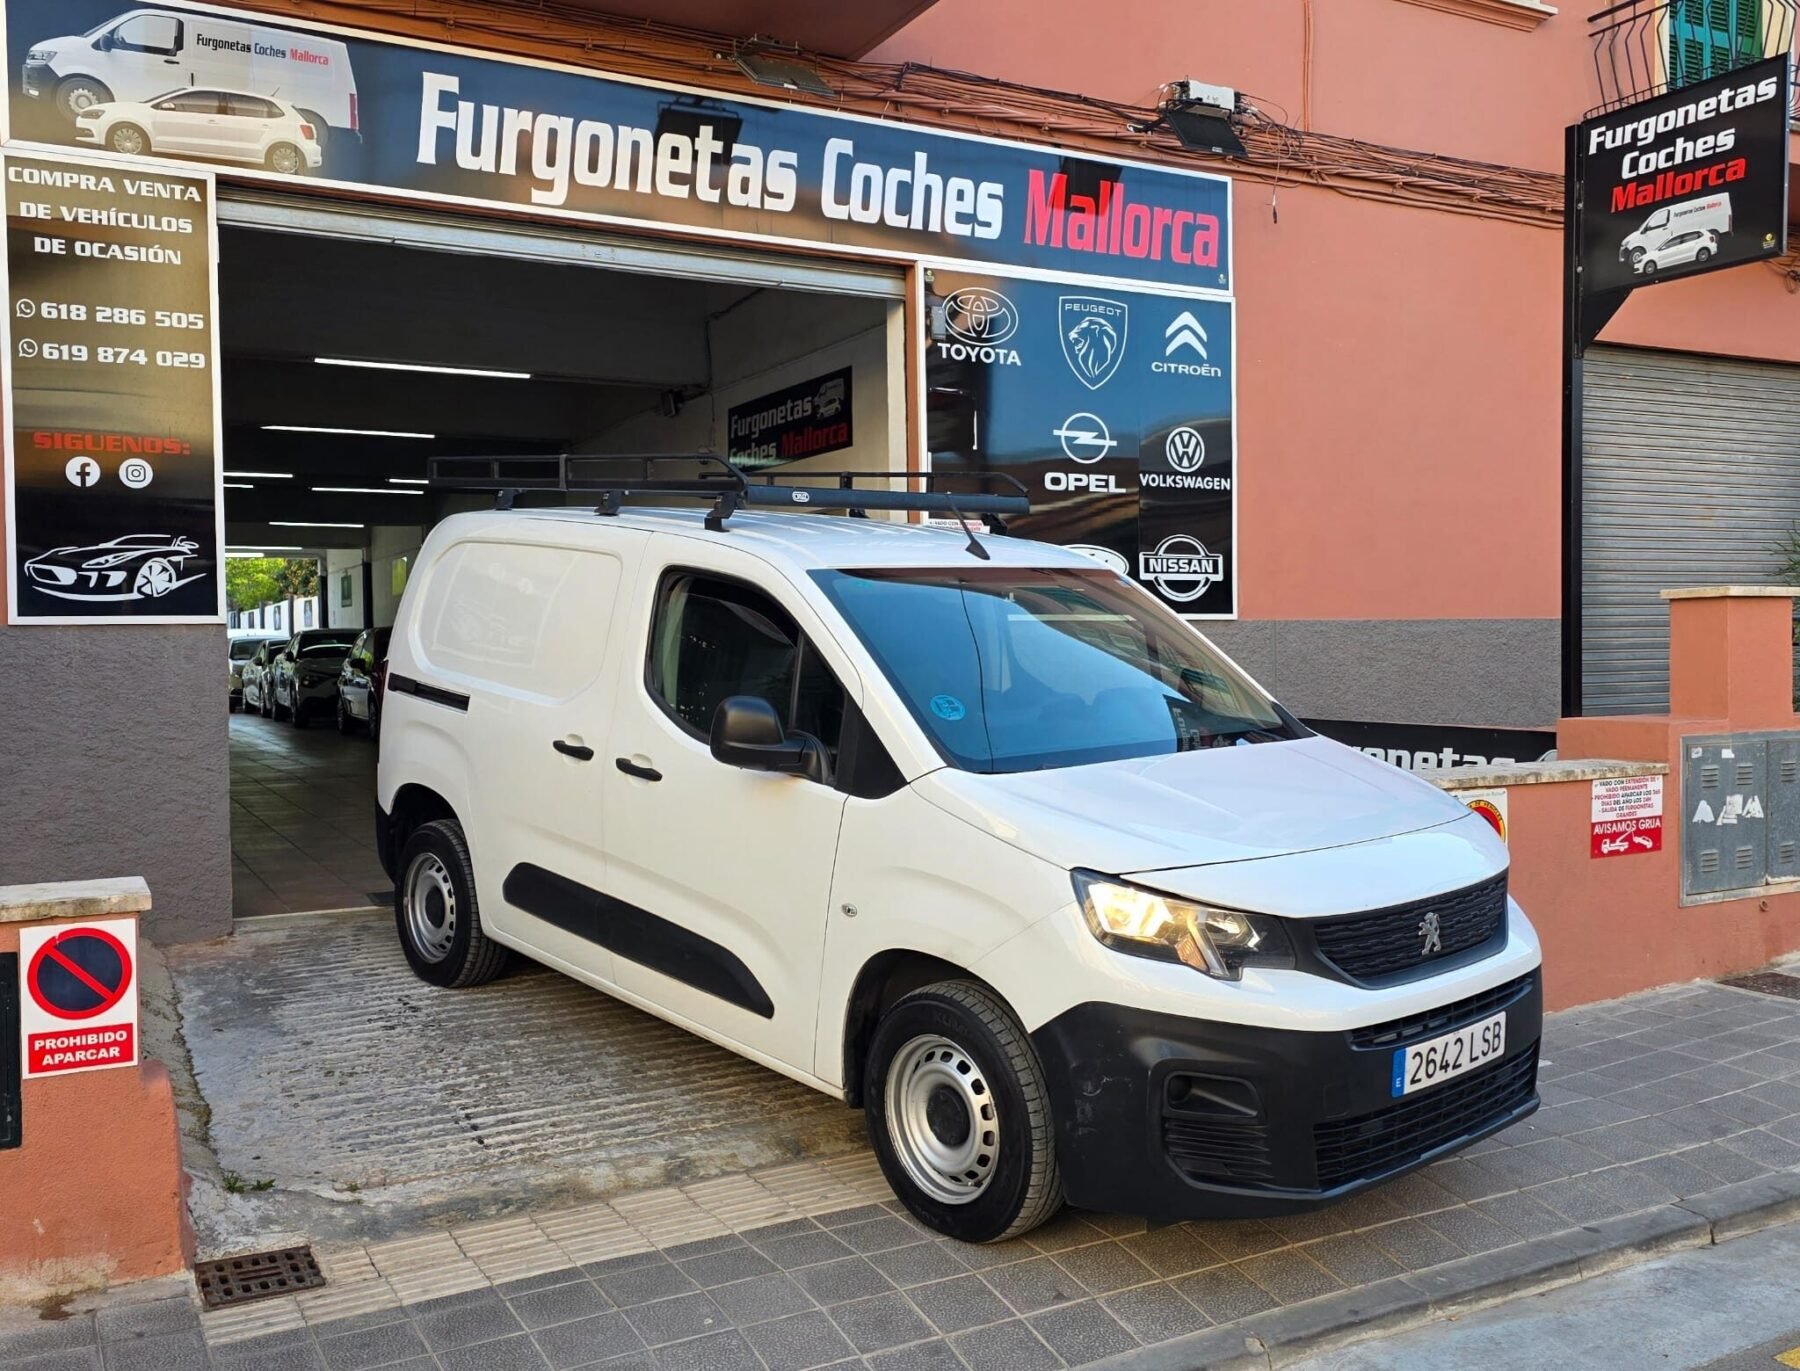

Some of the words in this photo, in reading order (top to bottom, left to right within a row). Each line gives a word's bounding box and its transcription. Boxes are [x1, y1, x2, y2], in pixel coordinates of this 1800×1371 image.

[197, 33, 251, 53] Furgonetas
[254, 42, 286, 59] Coches
[289, 48, 329, 65] Mallorca
[1588, 76, 1777, 156] Furgonetas
[1621, 128, 1736, 180] Coches
[417, 71, 798, 212] Furgonetas
[821, 137, 1004, 240] Coches
[1024, 168, 1219, 268] Mallorca
[8, 166, 116, 193] COMPRA
[122, 178, 202, 202] VENTA
[1611, 157, 1747, 213] Mallorca
[19, 201, 52, 220] DE
[60, 206, 193, 234] VEHÍCULOS
[34, 236, 66, 255] DE
[74, 241, 181, 265] OCASIÓN
[41, 302, 87, 321] 618
[95, 306, 147, 326] 286
[155, 310, 204, 330] 505
[1065, 303, 1122, 317] PEUGEOT
[42, 342, 89, 362] 619
[97, 347, 148, 366] 874
[155, 351, 206, 369] 029
[937, 342, 1022, 366] TOYOTA
[730, 396, 812, 439] Furgonetas
[32, 431, 191, 456] SIGUENOS:
[781, 422, 849, 458] Mallorca
[1044, 472, 1127, 494] OPEL
[1139, 473, 1231, 491] VOLKSWAGEN
[1149, 557, 1214, 574] NISSAN
[1621, 790, 1642, 798] APARCAR
[1594, 820, 1636, 835] AVISAMOS
[1638, 818, 1661, 830] GRUA
[34, 1030, 128, 1051] PROHIBIDO
[1410, 1037, 1464, 1086] 2642
[1469, 1021, 1502, 1064] LSB
[42, 1046, 120, 1066] APARCAR
